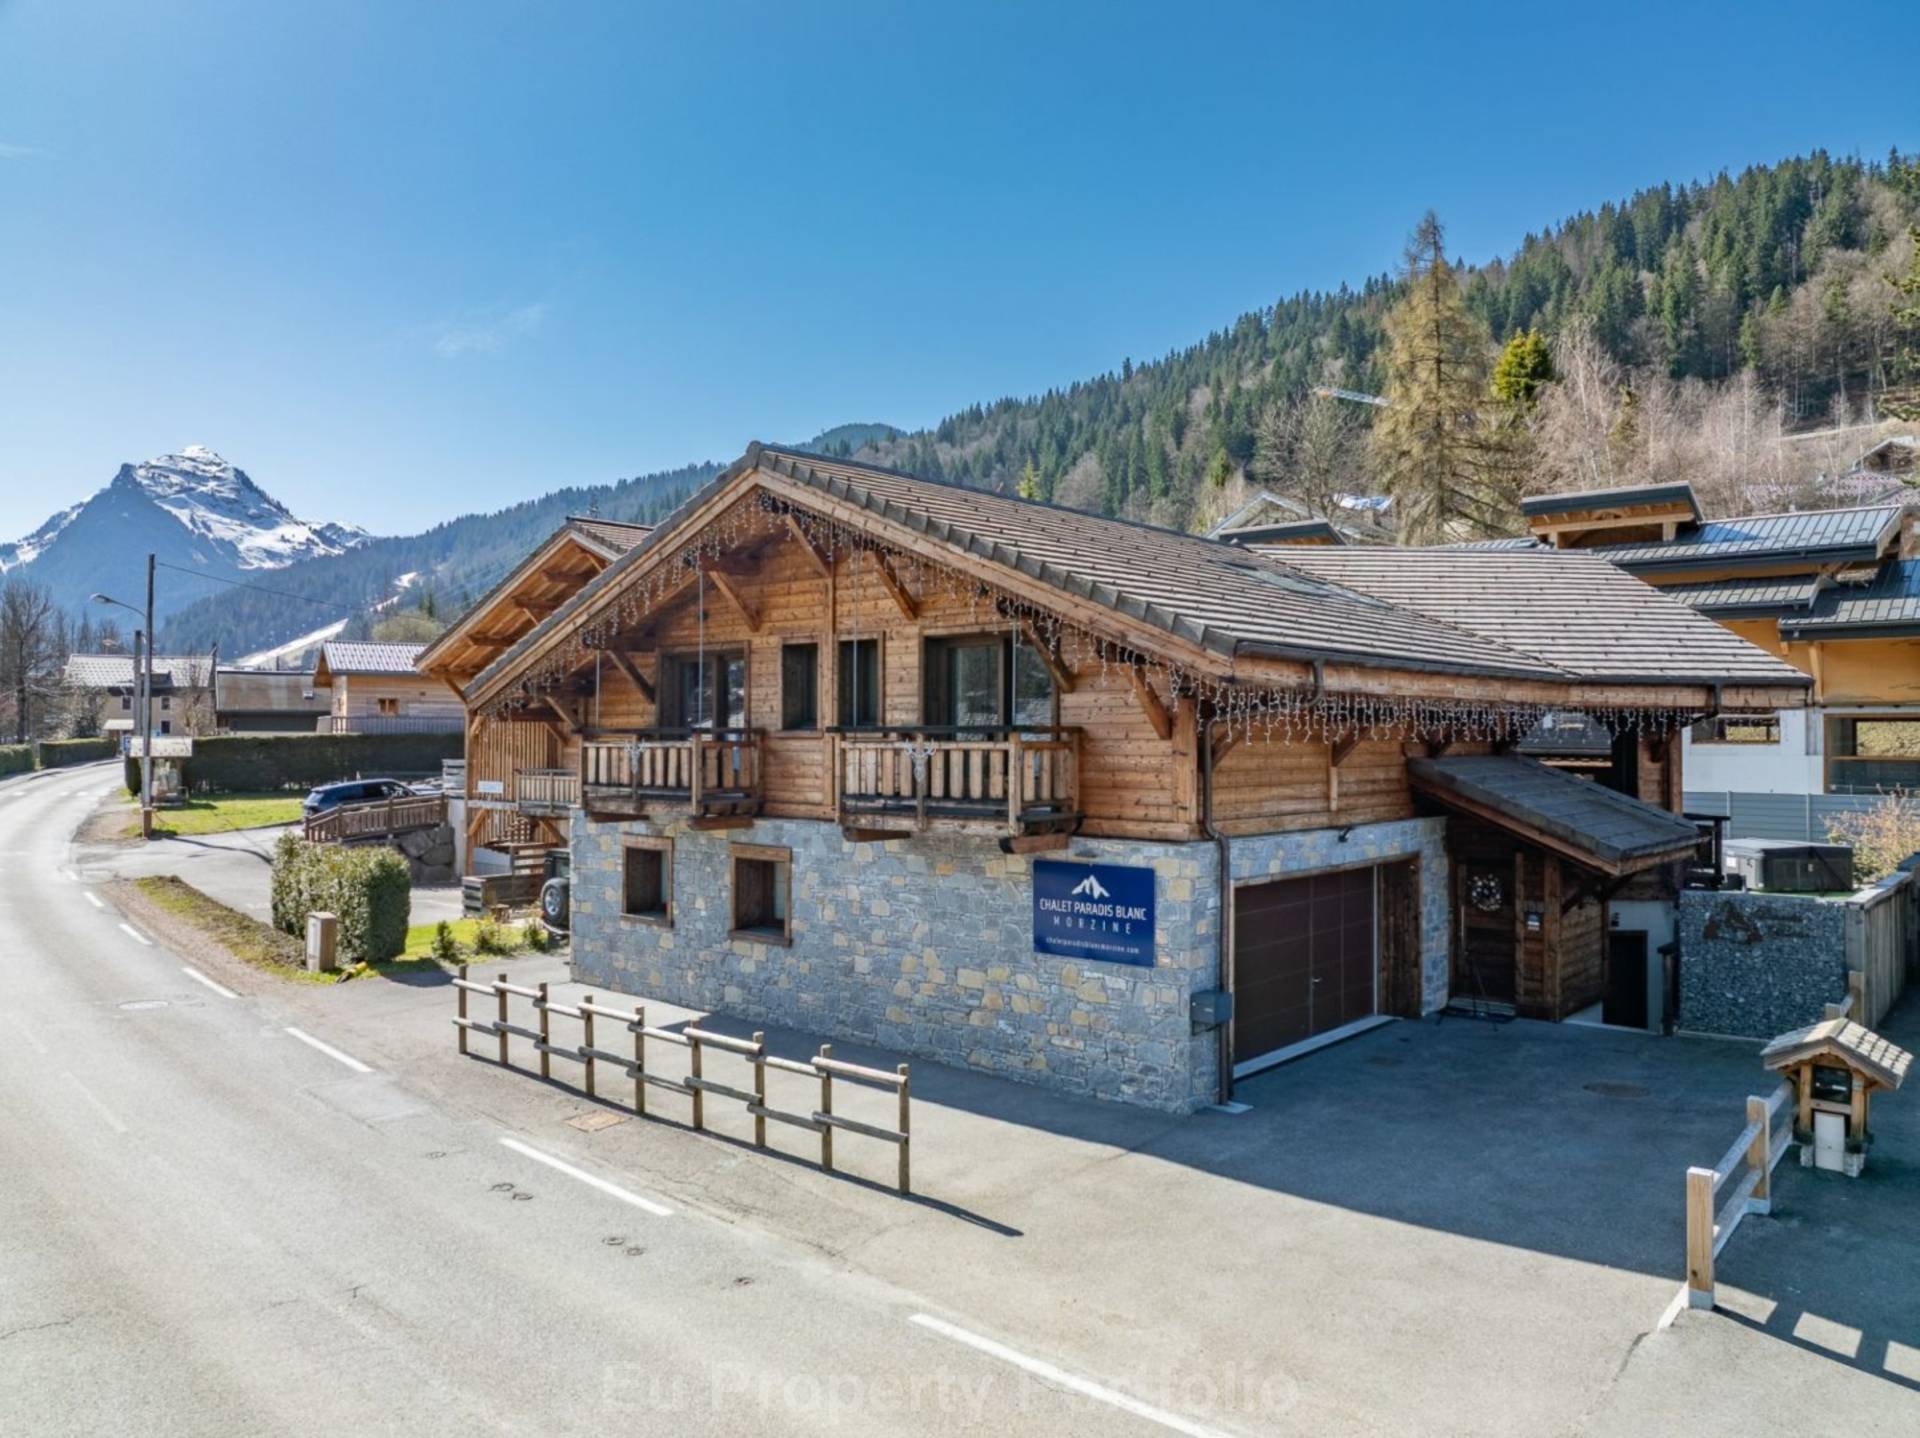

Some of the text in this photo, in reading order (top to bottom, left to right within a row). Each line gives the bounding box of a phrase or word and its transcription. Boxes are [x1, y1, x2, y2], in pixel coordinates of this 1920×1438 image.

[1039, 898, 1147, 921] CHALET PARADIS BLANC
[1053, 915, 1131, 935] MORZINE
